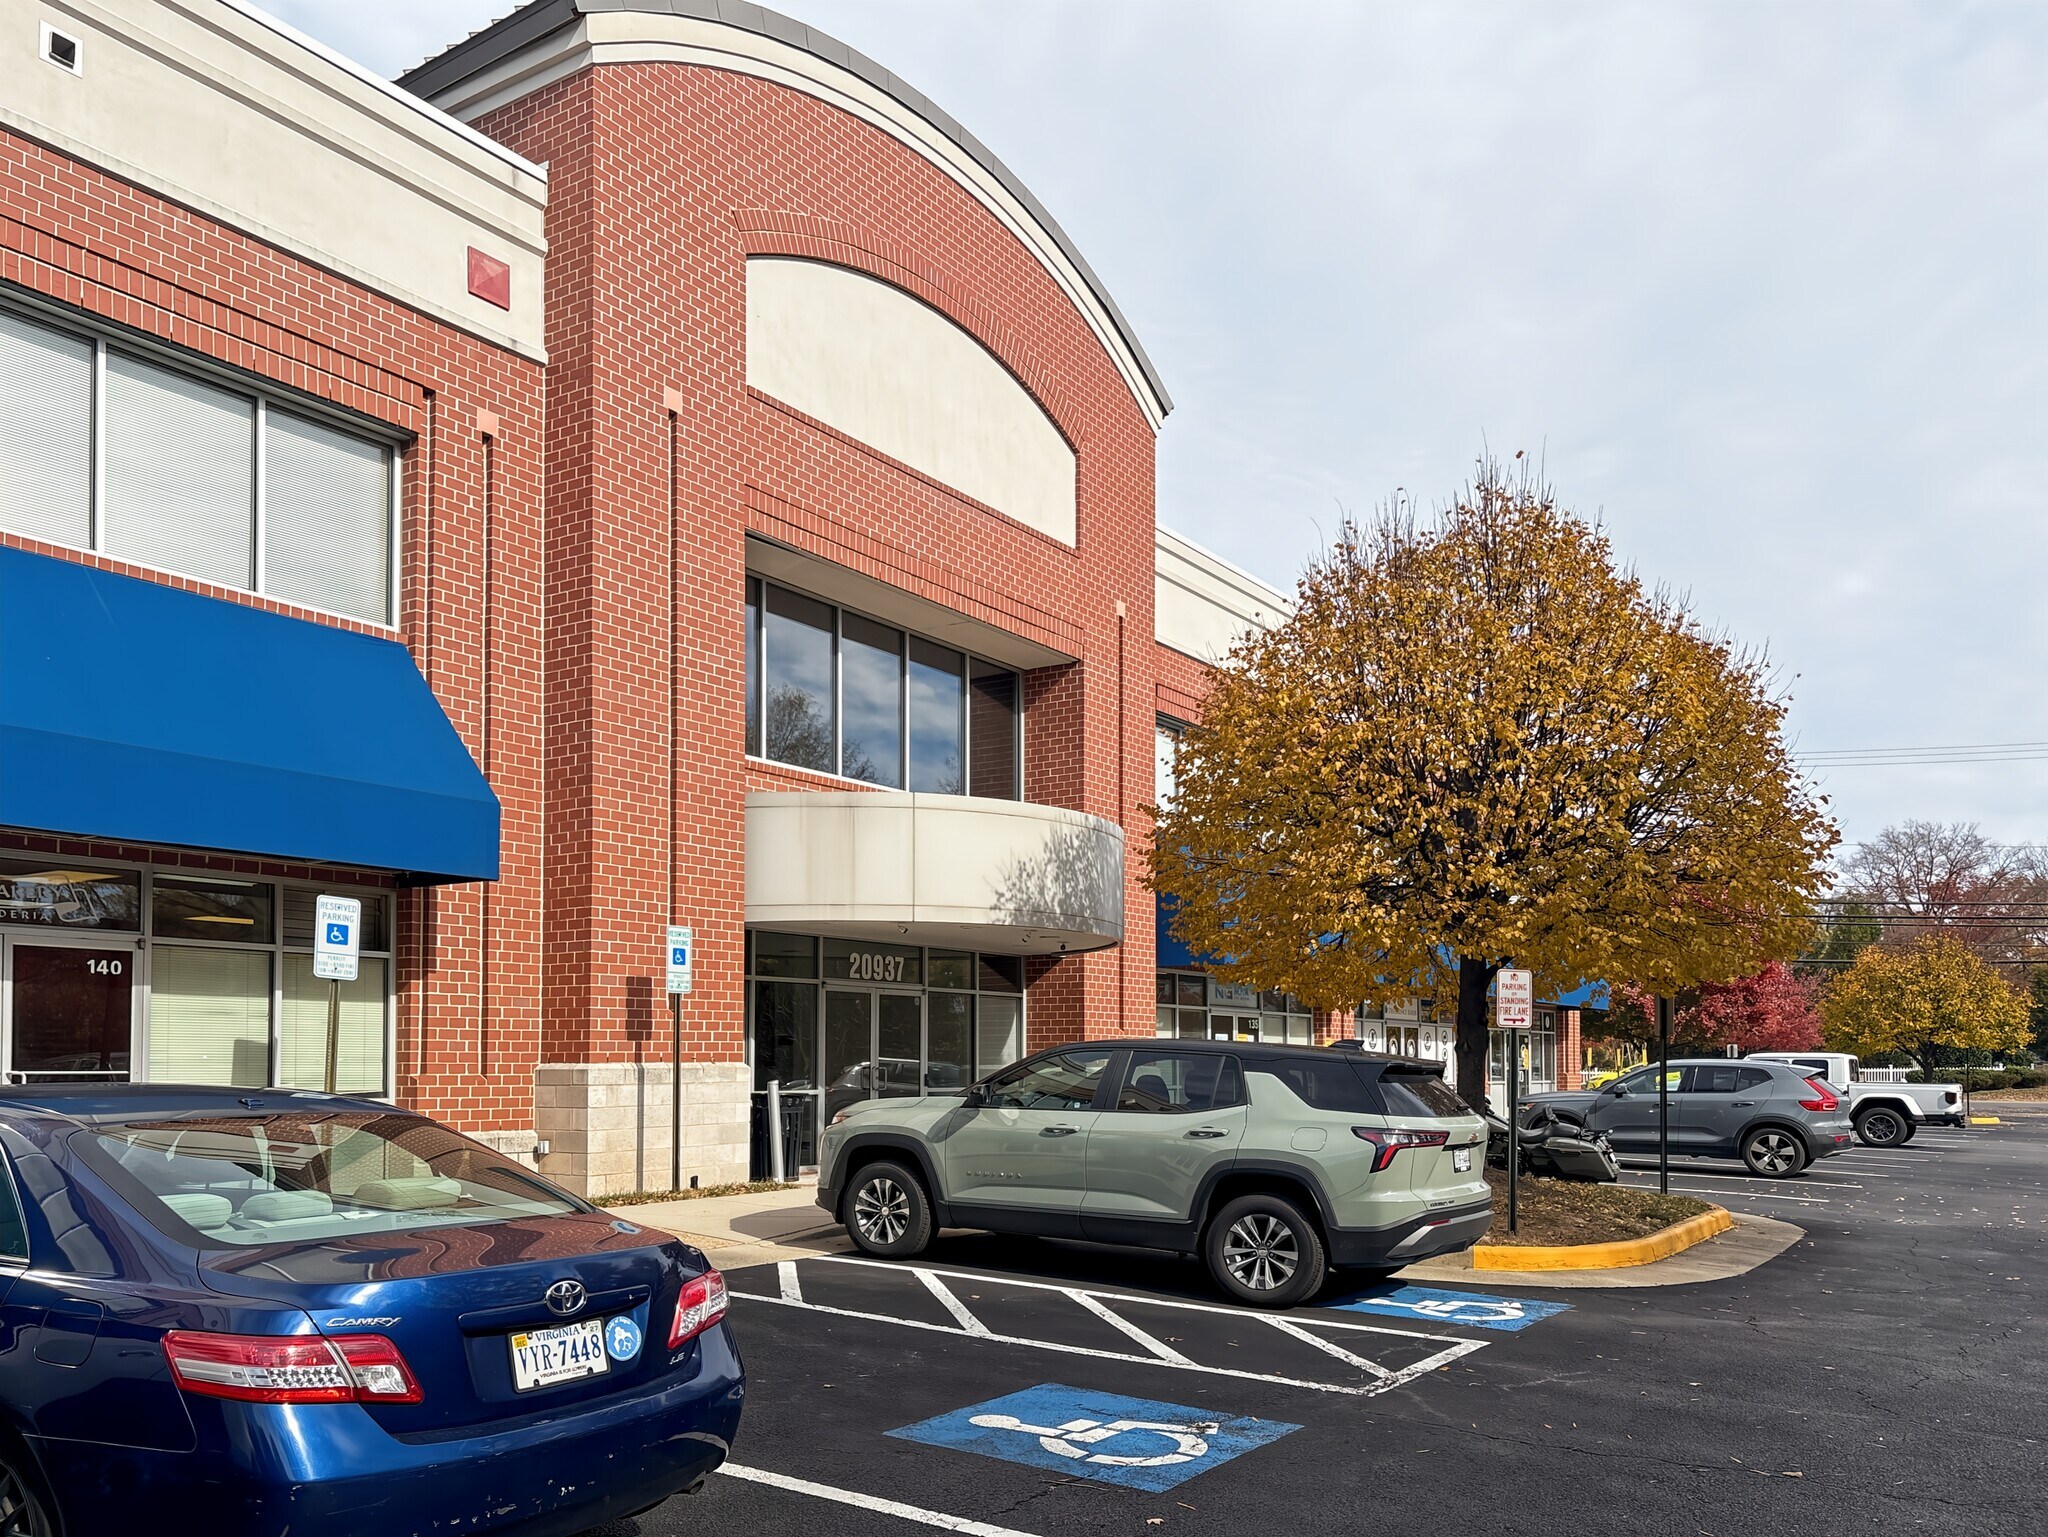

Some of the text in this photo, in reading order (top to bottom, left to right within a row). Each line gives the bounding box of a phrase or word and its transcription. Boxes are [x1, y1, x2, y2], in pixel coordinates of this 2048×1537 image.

[320, 901, 357, 913] RESERVED
[322, 912, 354, 923] PARKING
[87, 959, 122, 975] 140
[850, 952, 905, 981] 20937
[1501, 983, 1527, 991] PARKING
[1500, 997, 1529, 1005] STANDING
[1500, 1006, 1529, 1016] FIRE LANE
[326, 1317, 402, 1327] CAMRY
[535, 1326, 580, 1342] VIRGINIA
[589, 1325, 599, 1333] 27
[517, 1333, 602, 1374] VYR-7448
[669, 1351, 686, 1365] LE
